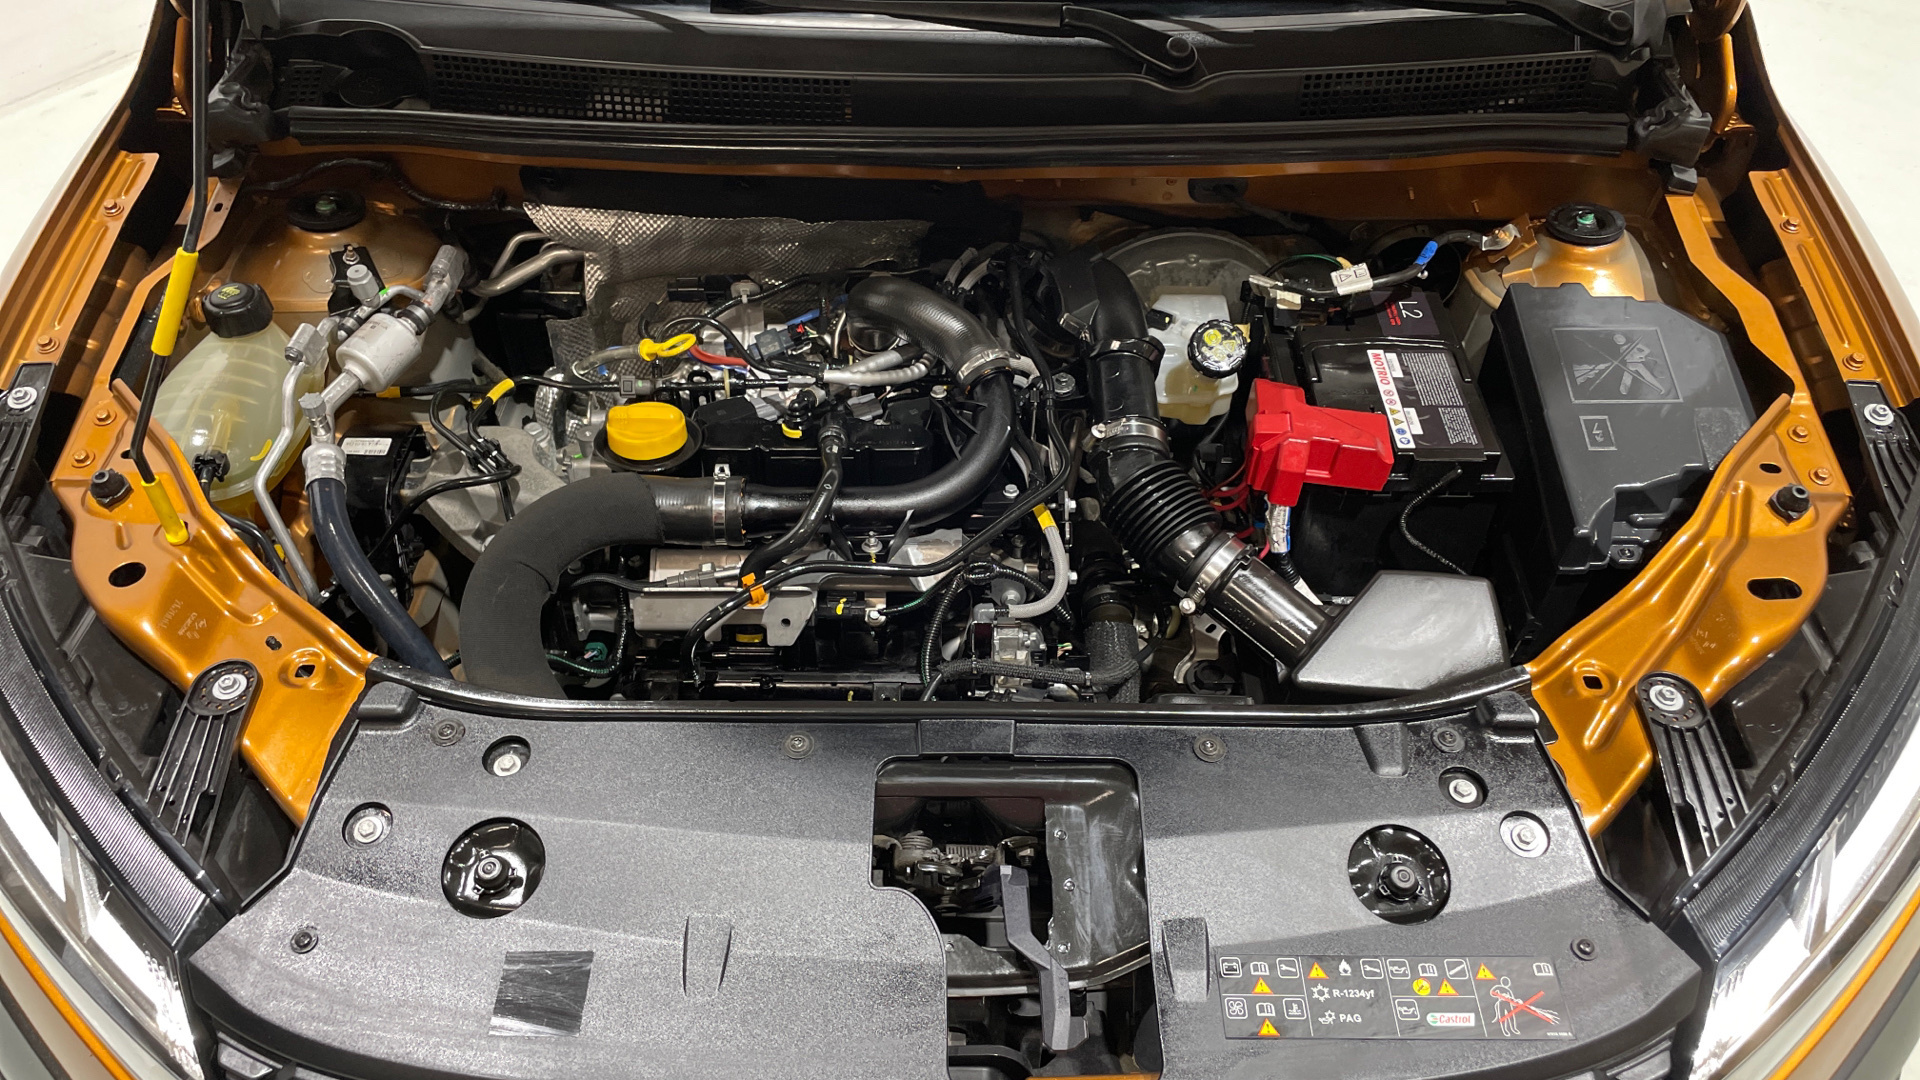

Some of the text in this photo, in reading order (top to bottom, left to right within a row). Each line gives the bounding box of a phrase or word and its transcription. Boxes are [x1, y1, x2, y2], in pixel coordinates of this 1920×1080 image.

[1398, 301, 1423, 318] L2
[1370, 352, 1391, 386] MOTRIO
[1339, 1013, 1362, 1023] PAG
[1439, 1014, 1471, 1024] Castrol
